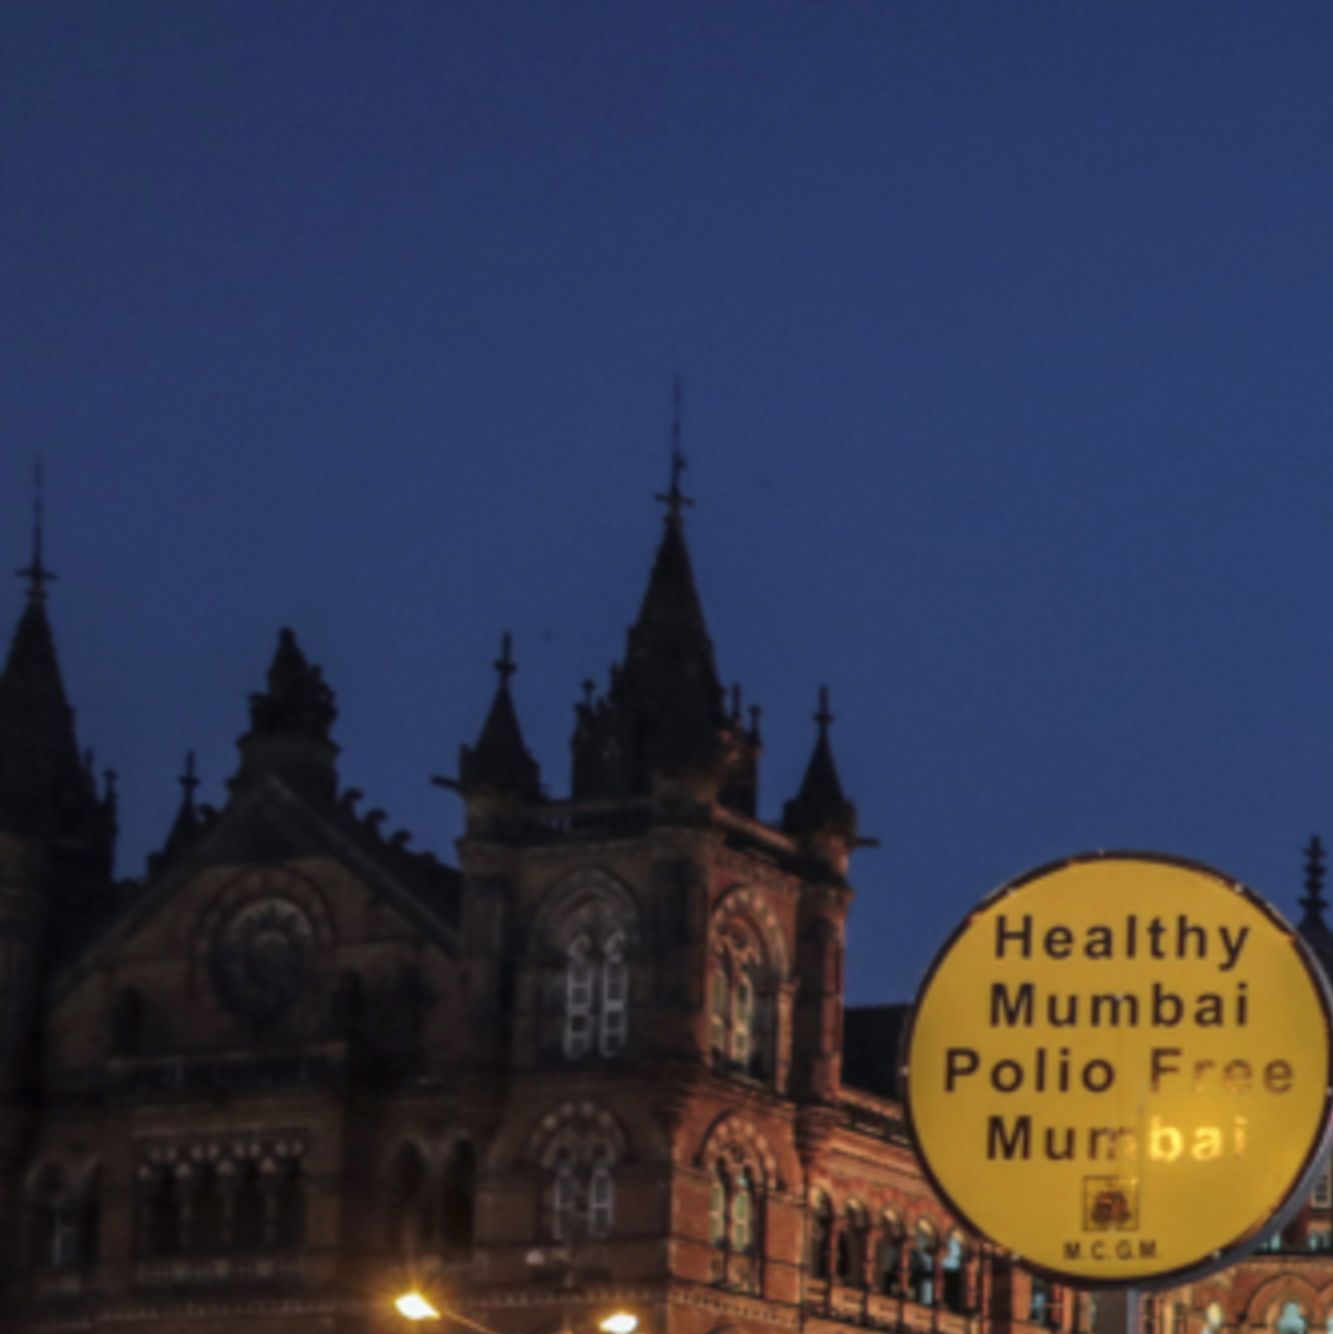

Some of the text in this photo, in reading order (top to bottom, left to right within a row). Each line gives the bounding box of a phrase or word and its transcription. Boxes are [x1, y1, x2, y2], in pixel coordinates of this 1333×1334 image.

[994, 914, 1250, 972] Healthy
[988, 982, 1249, 1027] Mumbai
[943, 1047, 1294, 1093] Polio Free
[986, 1115, 1249, 1162] Mumbai
